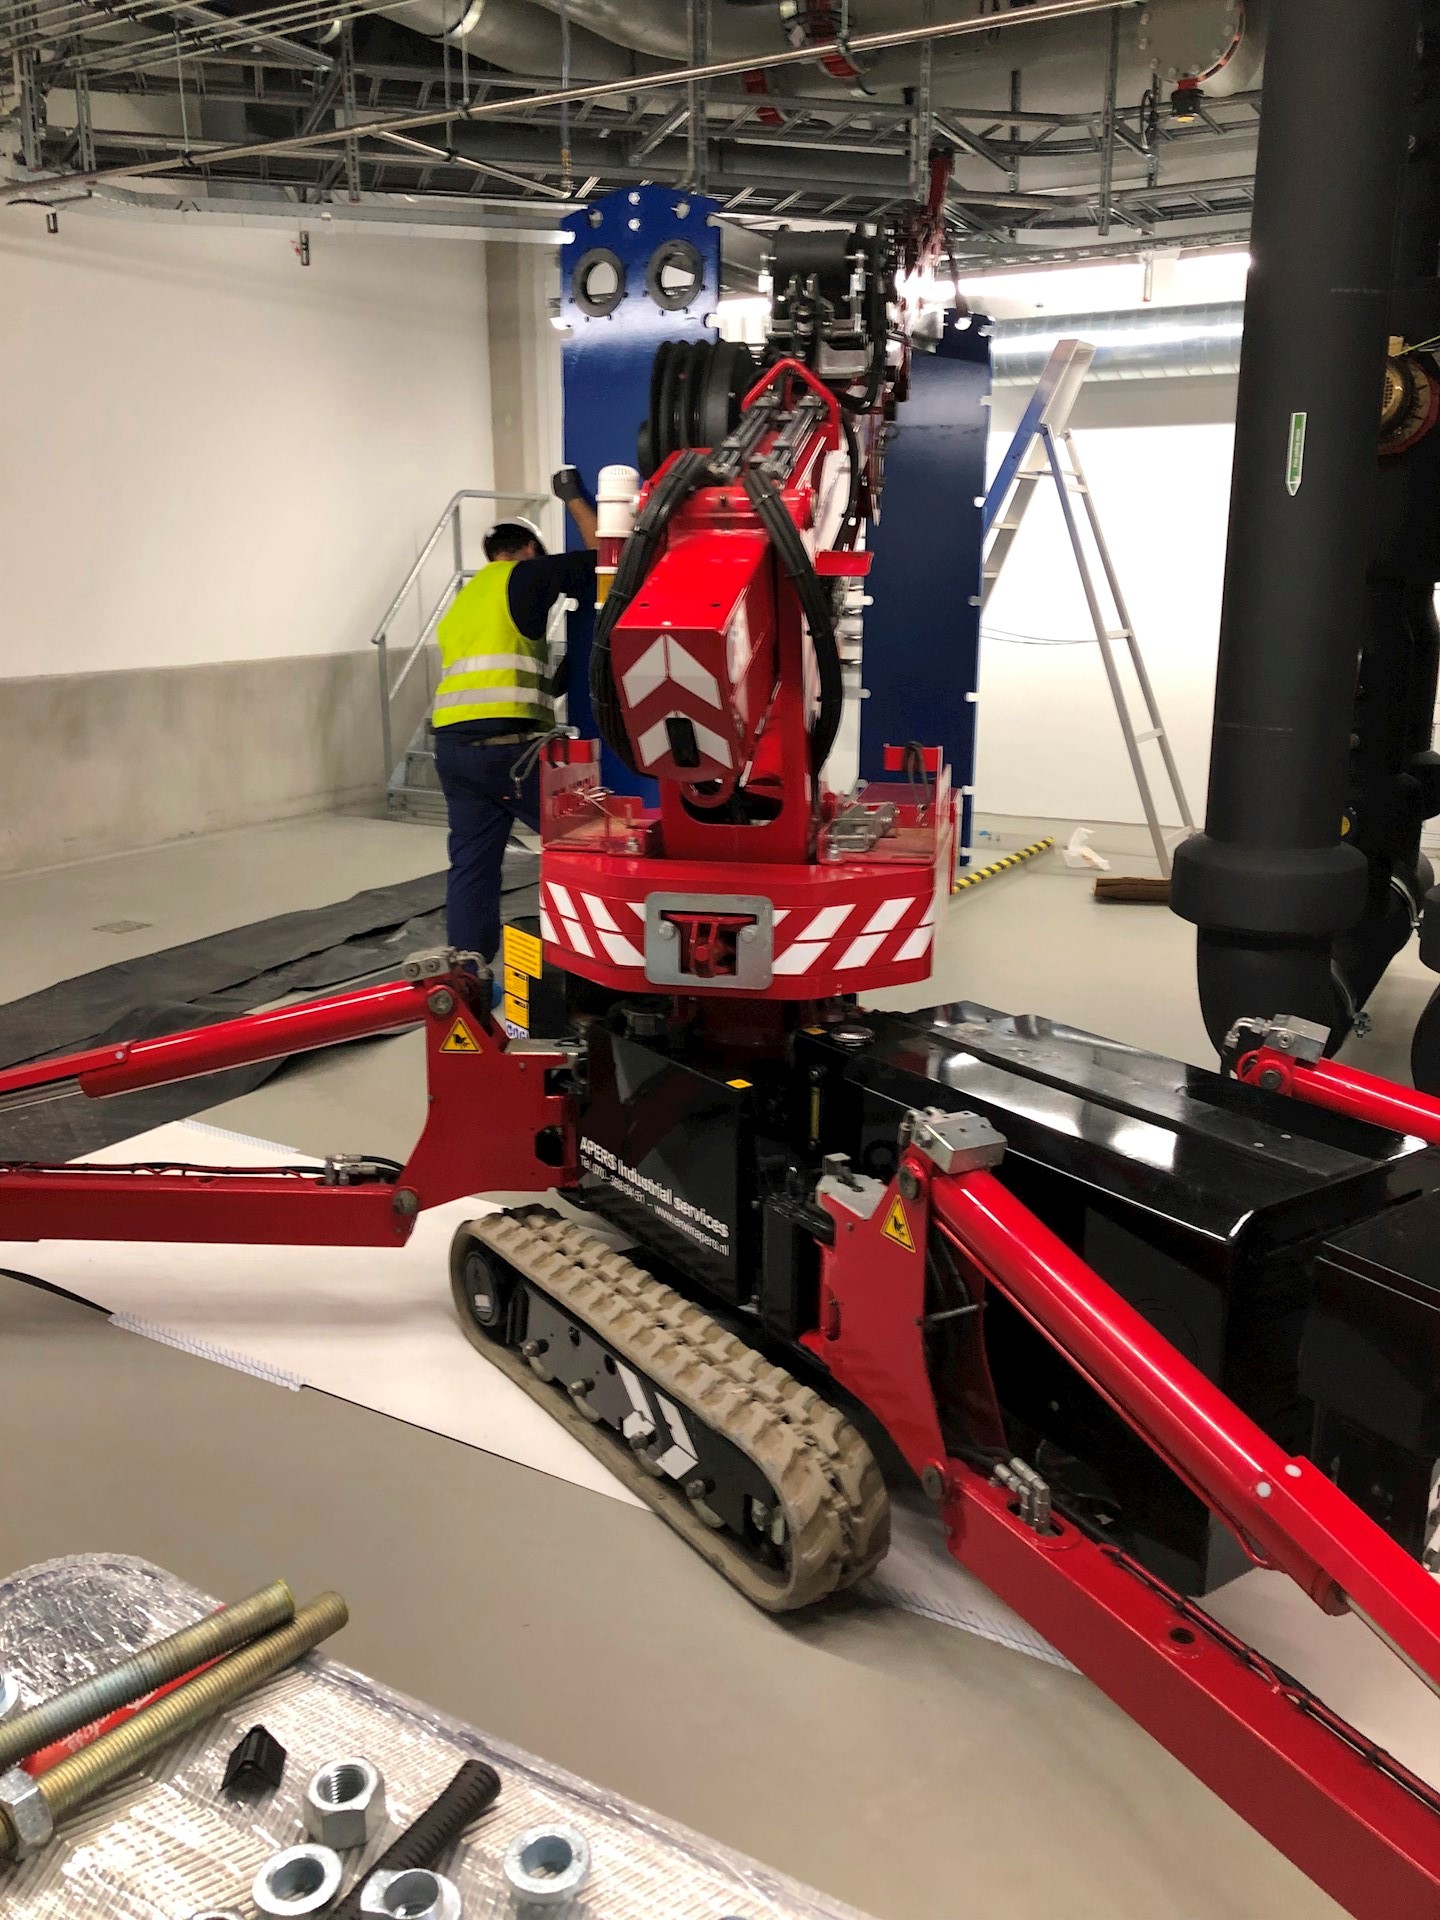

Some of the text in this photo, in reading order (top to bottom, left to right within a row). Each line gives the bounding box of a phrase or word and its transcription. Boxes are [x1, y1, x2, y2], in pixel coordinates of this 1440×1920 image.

[579, 1136, 618, 1171] APERS
[617, 1159, 673, 1205] Industrial
[673, 1196, 730, 1238] services
